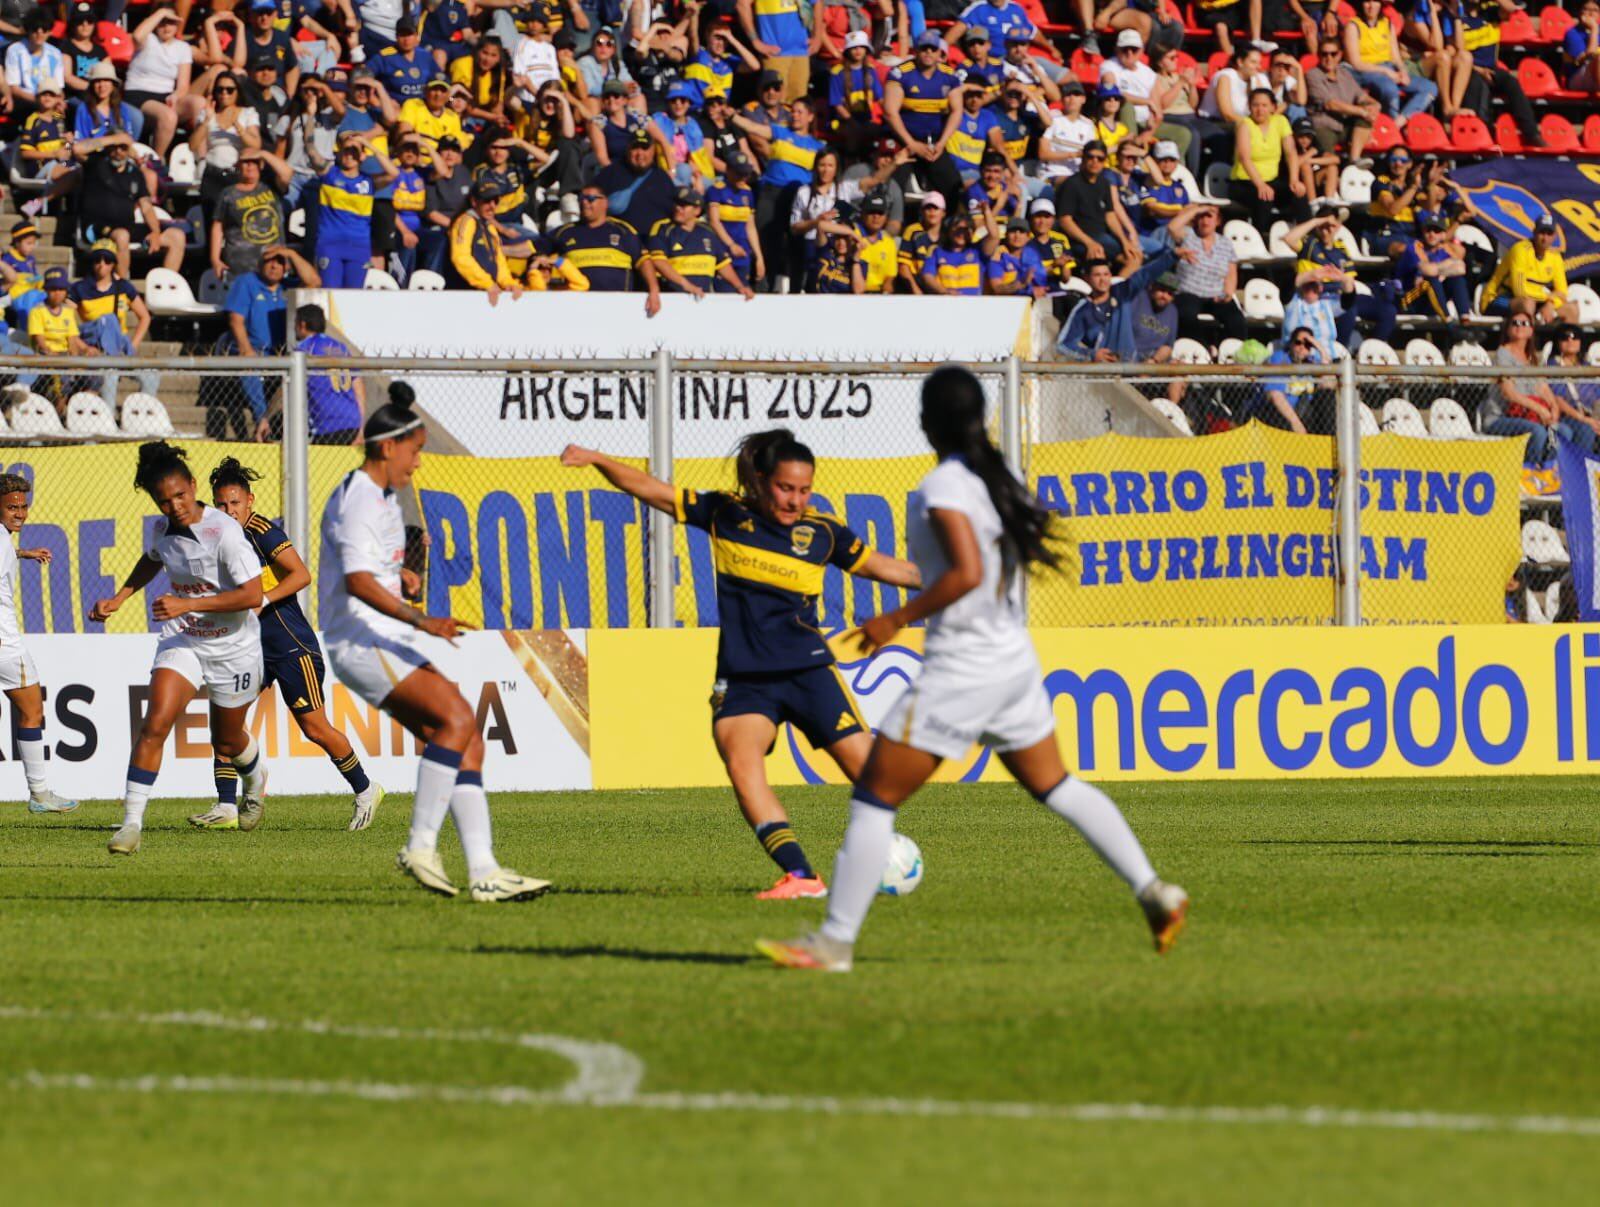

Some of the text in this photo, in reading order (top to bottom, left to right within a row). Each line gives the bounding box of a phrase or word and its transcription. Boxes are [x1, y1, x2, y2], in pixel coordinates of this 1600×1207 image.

[499, 376, 872, 421] ARGENINA 2025
[1036, 469, 1209, 519] ARRIO
[1220, 461, 1274, 509] EL
[731, 552, 799, 581] betsson
[1079, 532, 1428, 587] HURLINGHAM
[232, 672, 251, 692] 18
[1043, 635, 1529, 772] mercado
[0, 684, 98, 762] ES
[128, 681, 518, 759] FEMENIA
